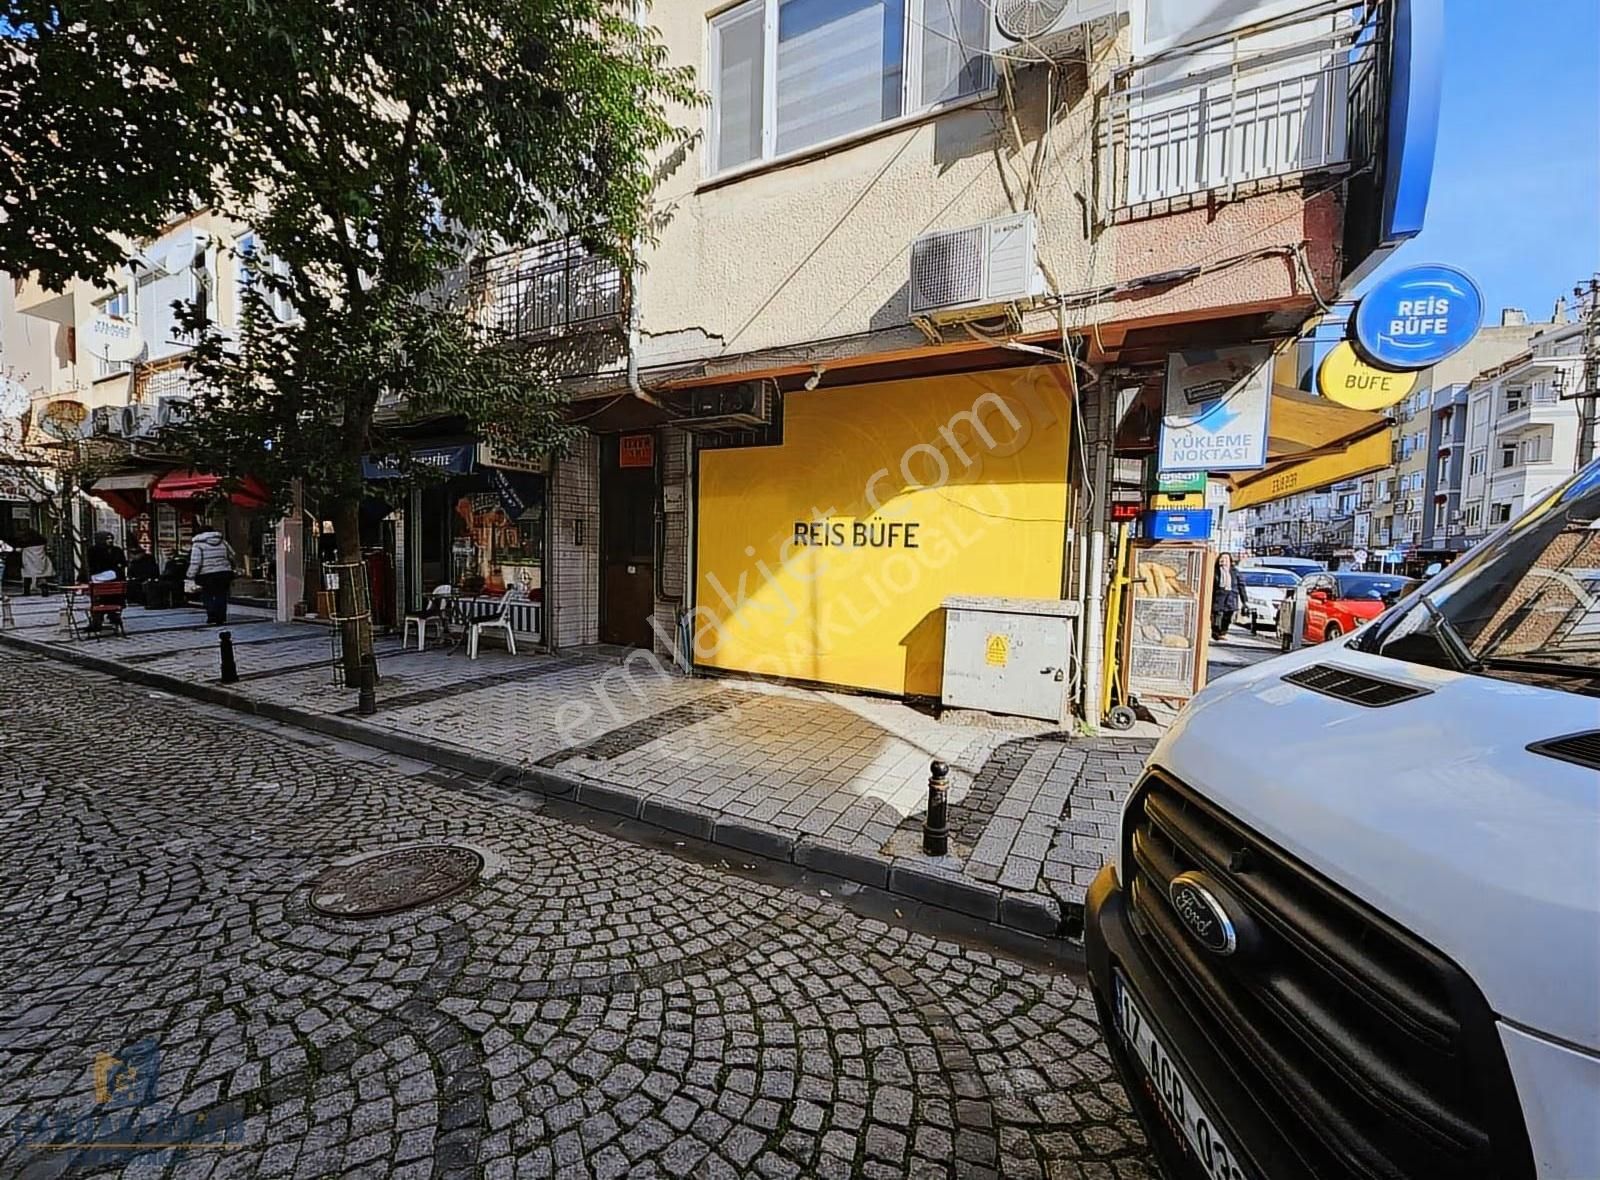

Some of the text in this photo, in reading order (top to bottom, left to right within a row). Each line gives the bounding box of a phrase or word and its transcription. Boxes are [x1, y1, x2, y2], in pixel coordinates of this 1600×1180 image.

[1398, 296, 1450, 316] REİS
[1389, 316, 1449, 336] BÜFE
[1344, 371, 1393, 391] BÜFE
[1171, 432, 1252, 449] YÜKLEME
[1173, 447, 1249, 463] NOKTASI
[794, 516, 920, 548] REİS BÜFE
[1175, 887, 1213, 937] Ford
[1123, 993, 1246, 1180] 17 ACB 03
